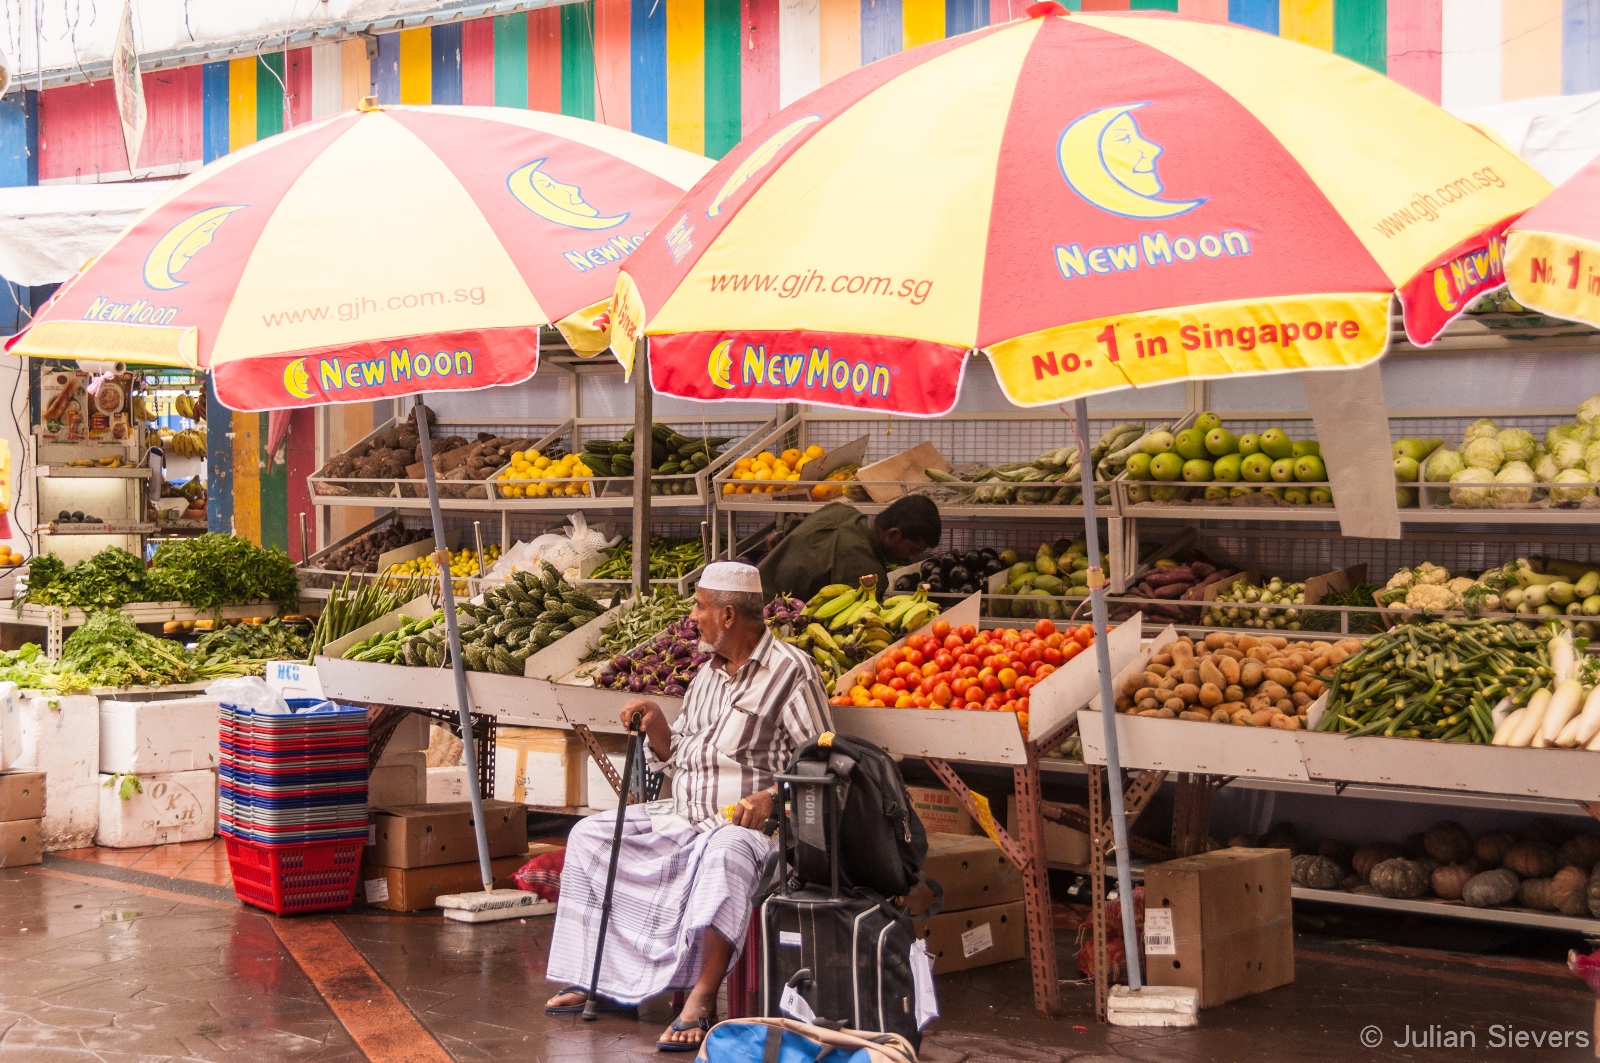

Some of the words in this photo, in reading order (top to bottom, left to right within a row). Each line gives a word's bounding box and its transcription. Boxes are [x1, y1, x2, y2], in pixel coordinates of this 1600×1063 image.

[1372, 166, 1506, 240] www.gjh.com.sg
[608, 231, 651, 256] Mo
[710, 269, 934, 305] www.gjh.com.sg
[1530, 257, 1556, 287] No.
[261, 286, 486, 328] www.gjh.com.sg
[1031, 351, 1094, 381] No.
[1133, 331, 1168, 359] in
[1180, 318, 1361, 352] Singapore
